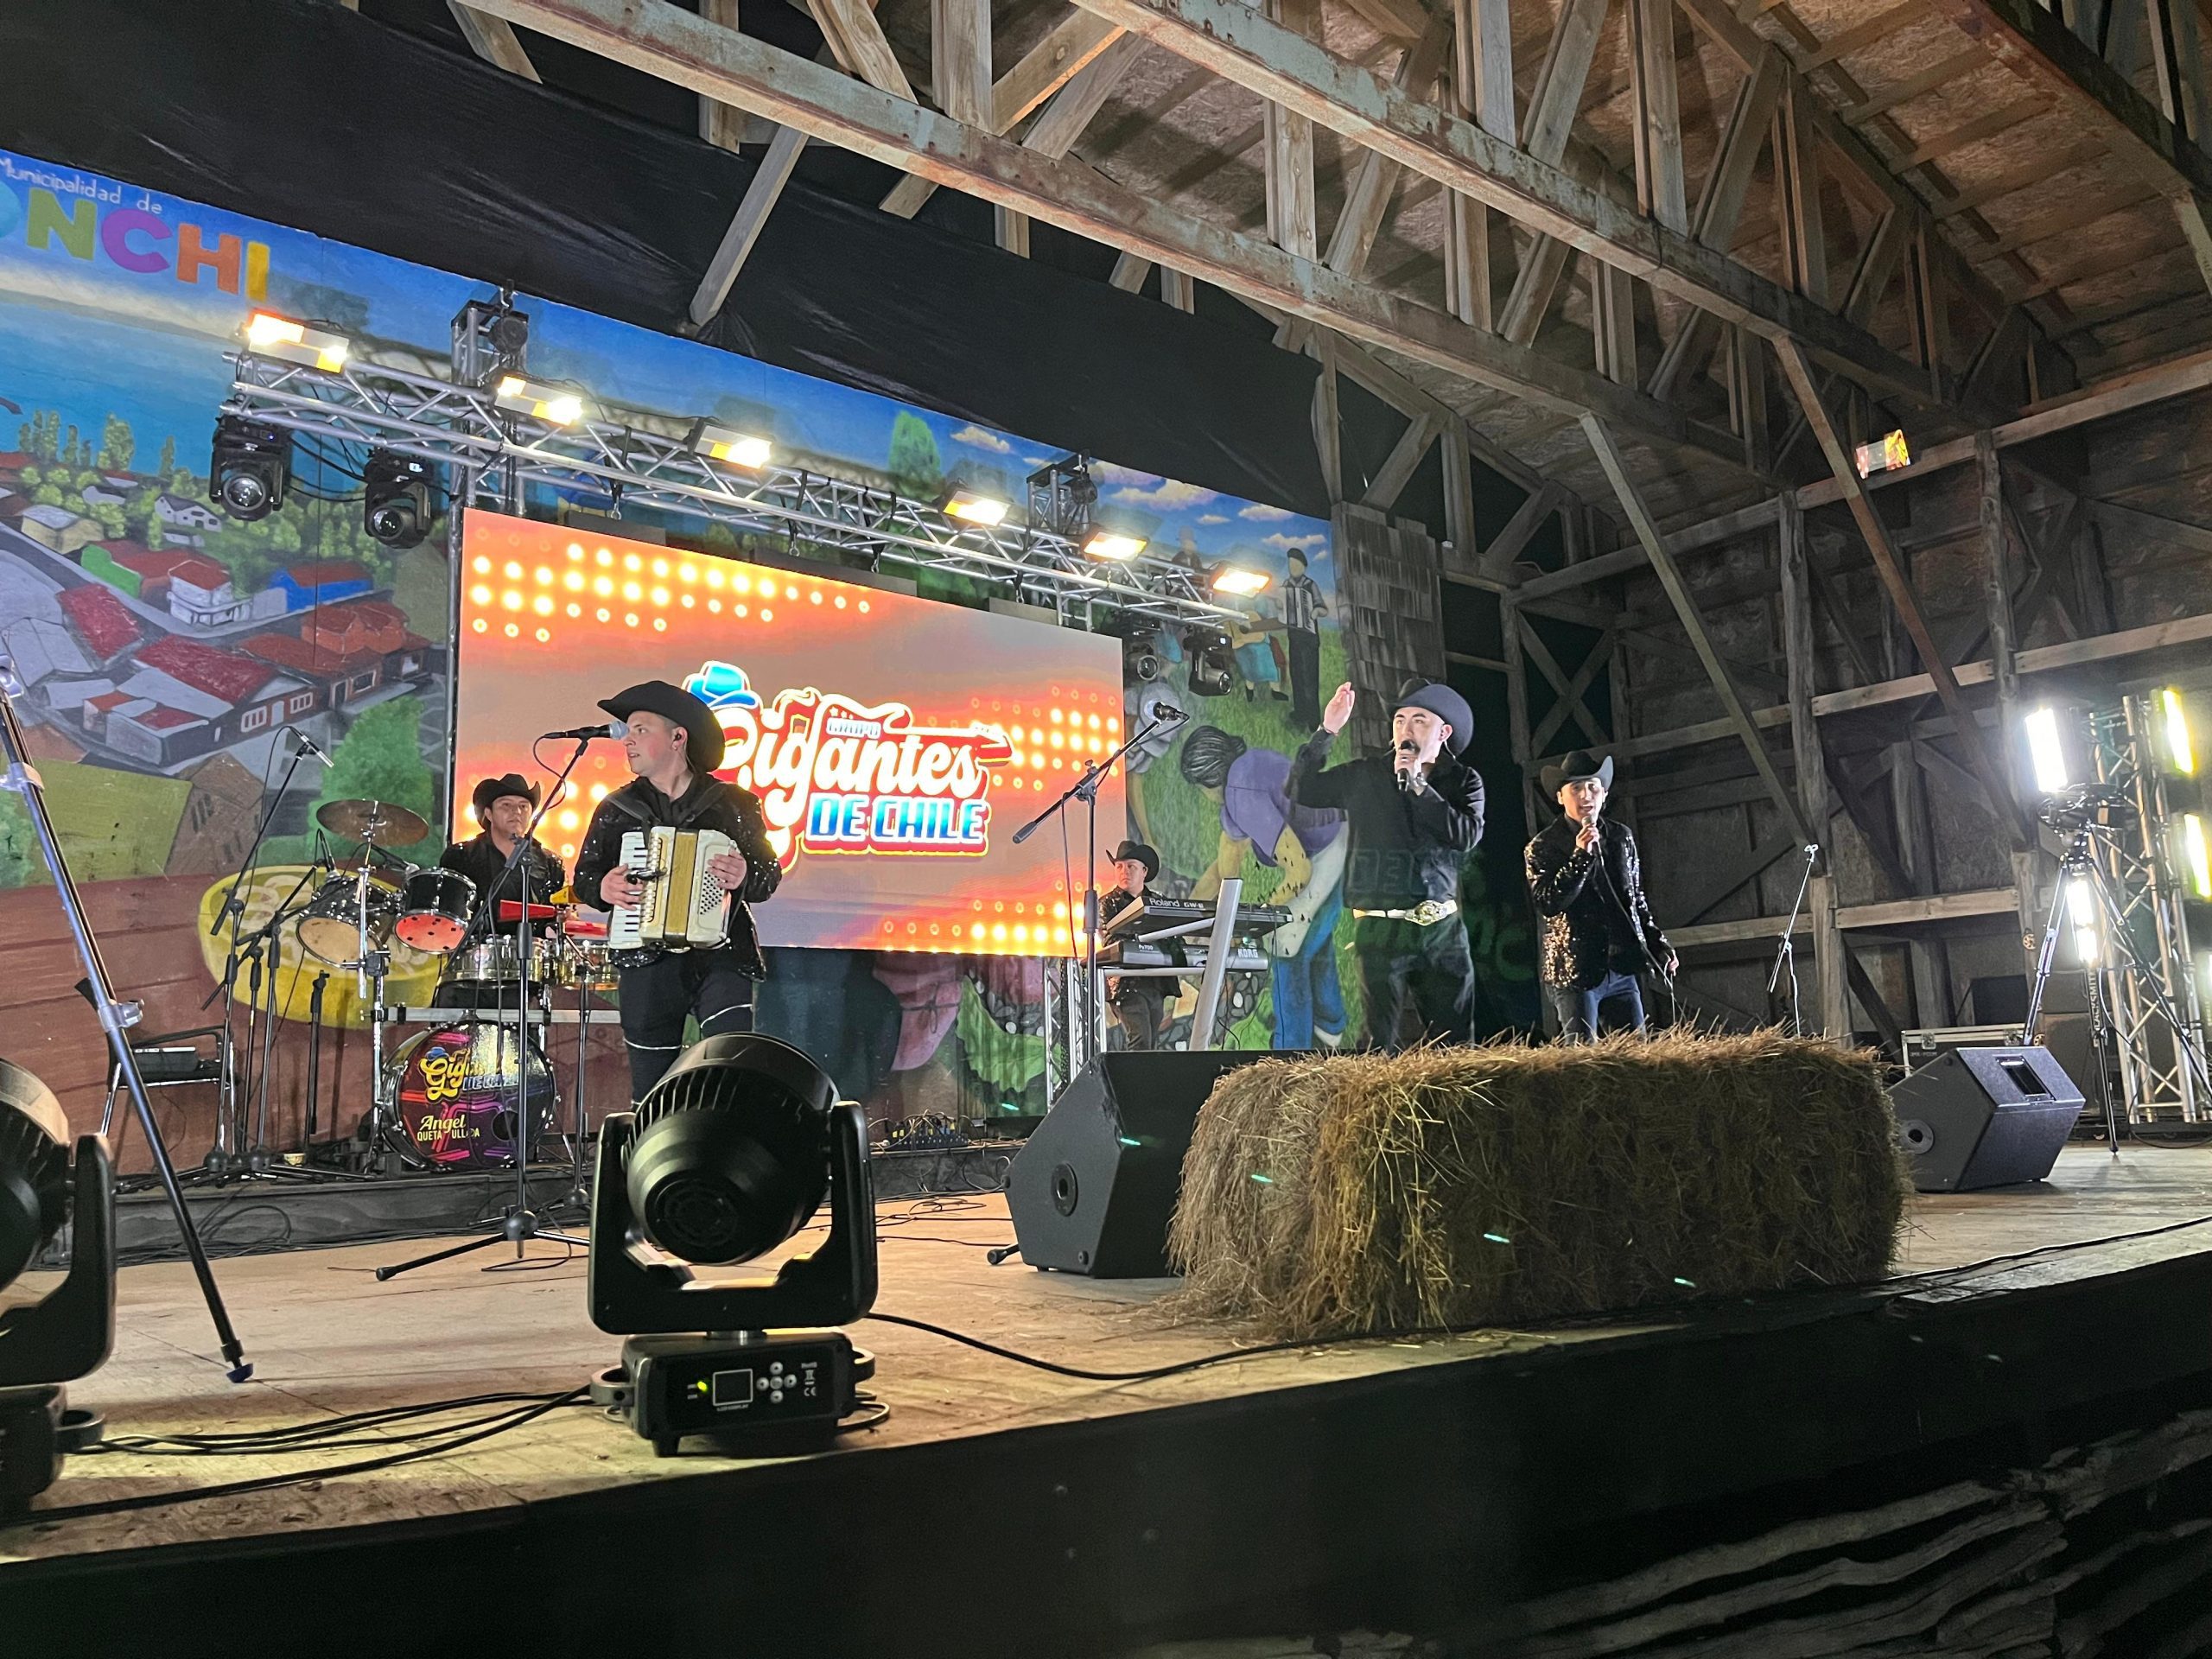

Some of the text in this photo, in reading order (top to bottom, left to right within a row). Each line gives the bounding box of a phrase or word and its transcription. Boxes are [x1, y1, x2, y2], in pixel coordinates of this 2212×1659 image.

[137, 192, 162, 214] de
[808, 796, 988, 844] DE CHILE
[1149, 898, 1180, 907] Roland
[1237, 948, 1259, 958] KORG
[2087, 969, 2101, 1031] LACKSMIT
[419, 1114, 467, 1134] Angel
[417, 1129, 442, 1141] QUETA
